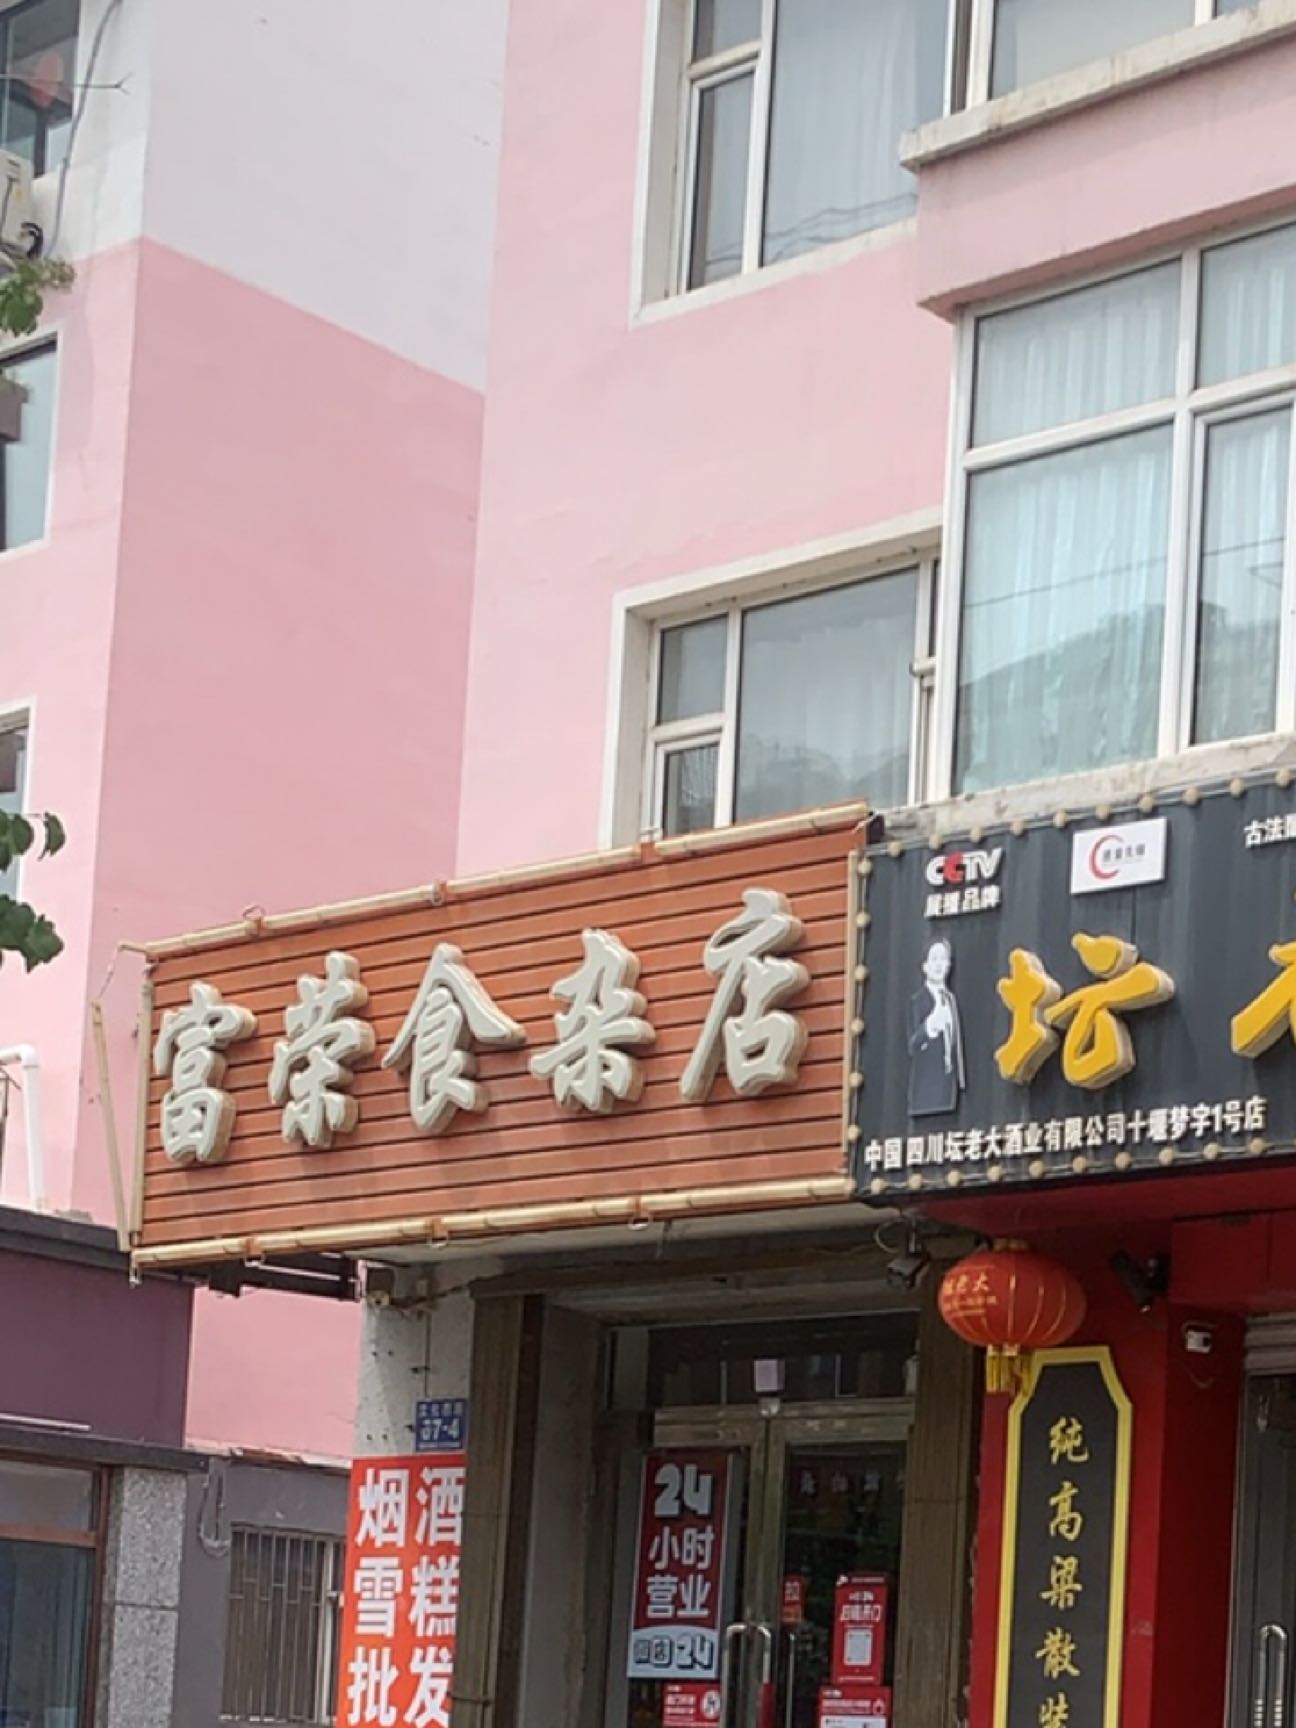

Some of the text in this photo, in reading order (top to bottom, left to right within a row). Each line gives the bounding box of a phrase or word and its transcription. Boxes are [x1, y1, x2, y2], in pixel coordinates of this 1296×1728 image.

[926, 847, 1002, 886] CCTV
[153, 887, 812, 1166] 富荣食杂店
[354, 1467, 464, 1548] 烟酒
[654, 1463, 713, 1519] 24
[649, 1524, 715, 1570] 小时
[352, 1554, 458, 1638] 雪糕
[647, 1574, 711, 1618] 营业
[347, 1646, 454, 1728] 批发
